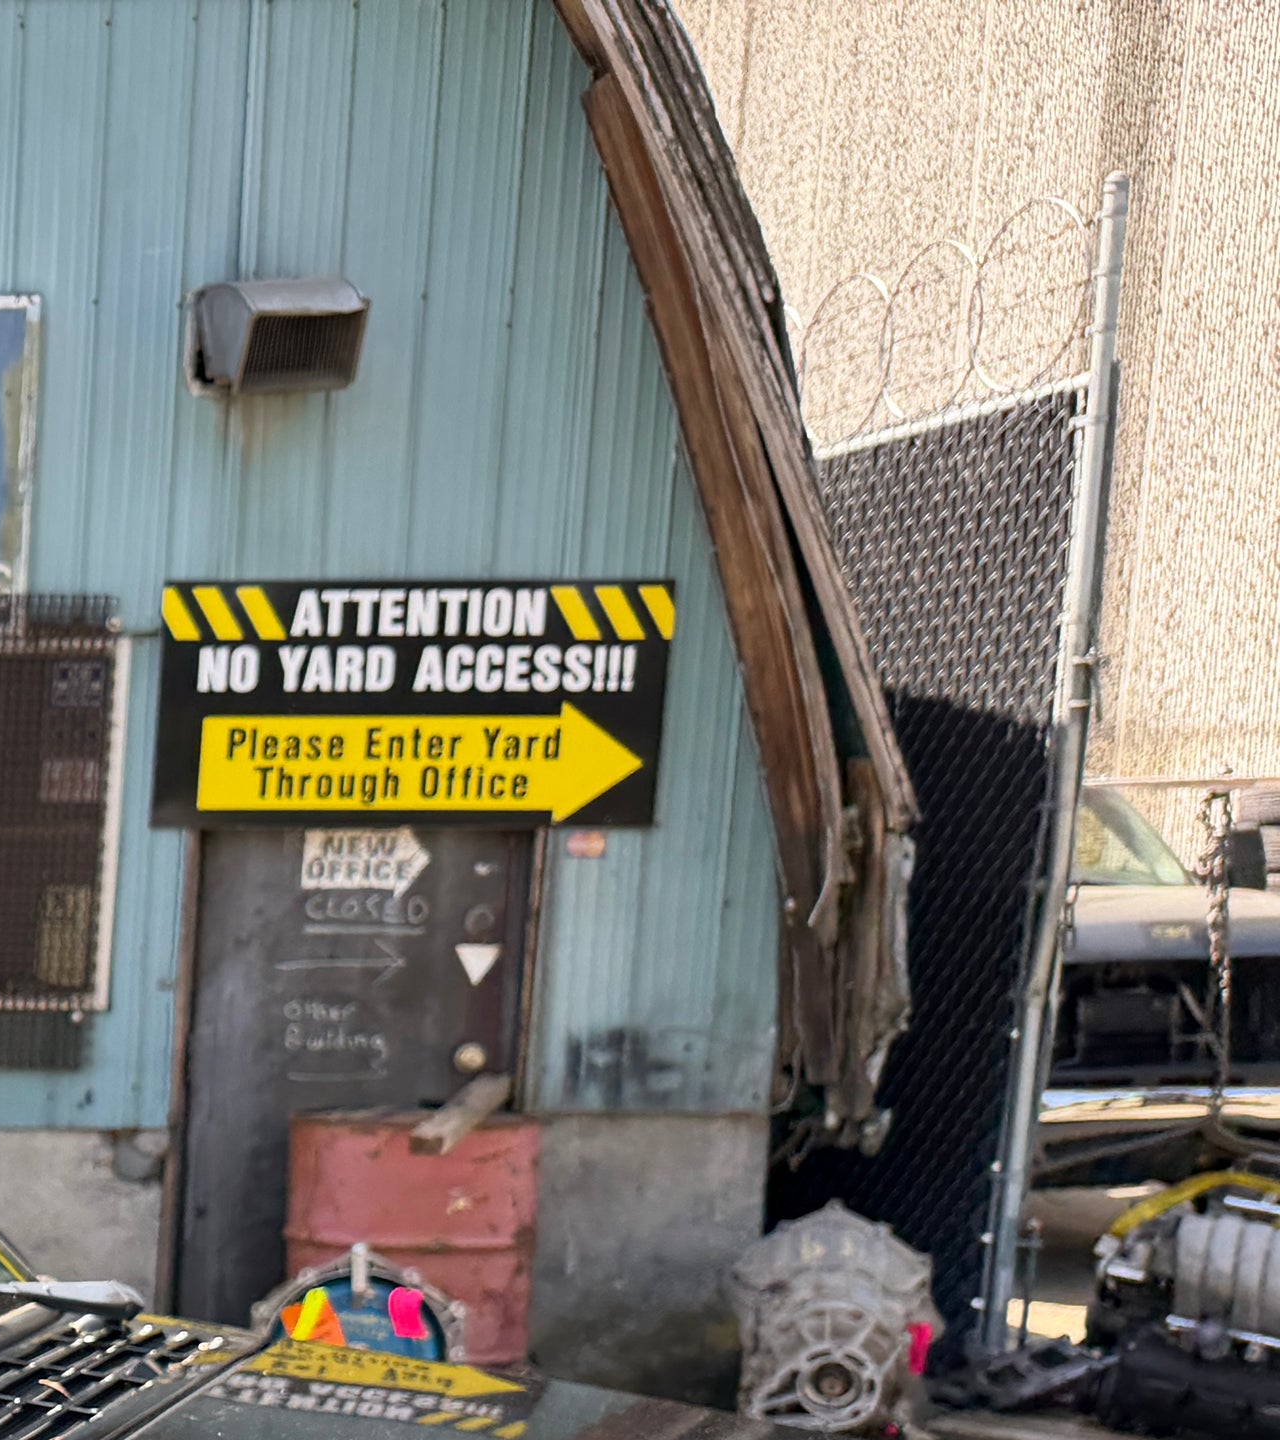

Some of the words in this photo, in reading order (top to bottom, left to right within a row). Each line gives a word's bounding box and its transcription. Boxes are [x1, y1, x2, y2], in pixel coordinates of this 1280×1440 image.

[289, 588, 547, 638] ATTENTION
[196, 645, 260, 693] NO
[278, 645, 396, 693] YARD
[412, 645, 637, 692] ACCESS!!!
[226, 727, 344, 760] Please
[365, 726, 462, 760] Enter
[484, 724, 562, 760] Yard
[254, 766, 400, 806] Through
[420, 765, 530, 799] Office
[323, 834, 399, 857] NEW
[307, 857, 411, 880] OFFICE
